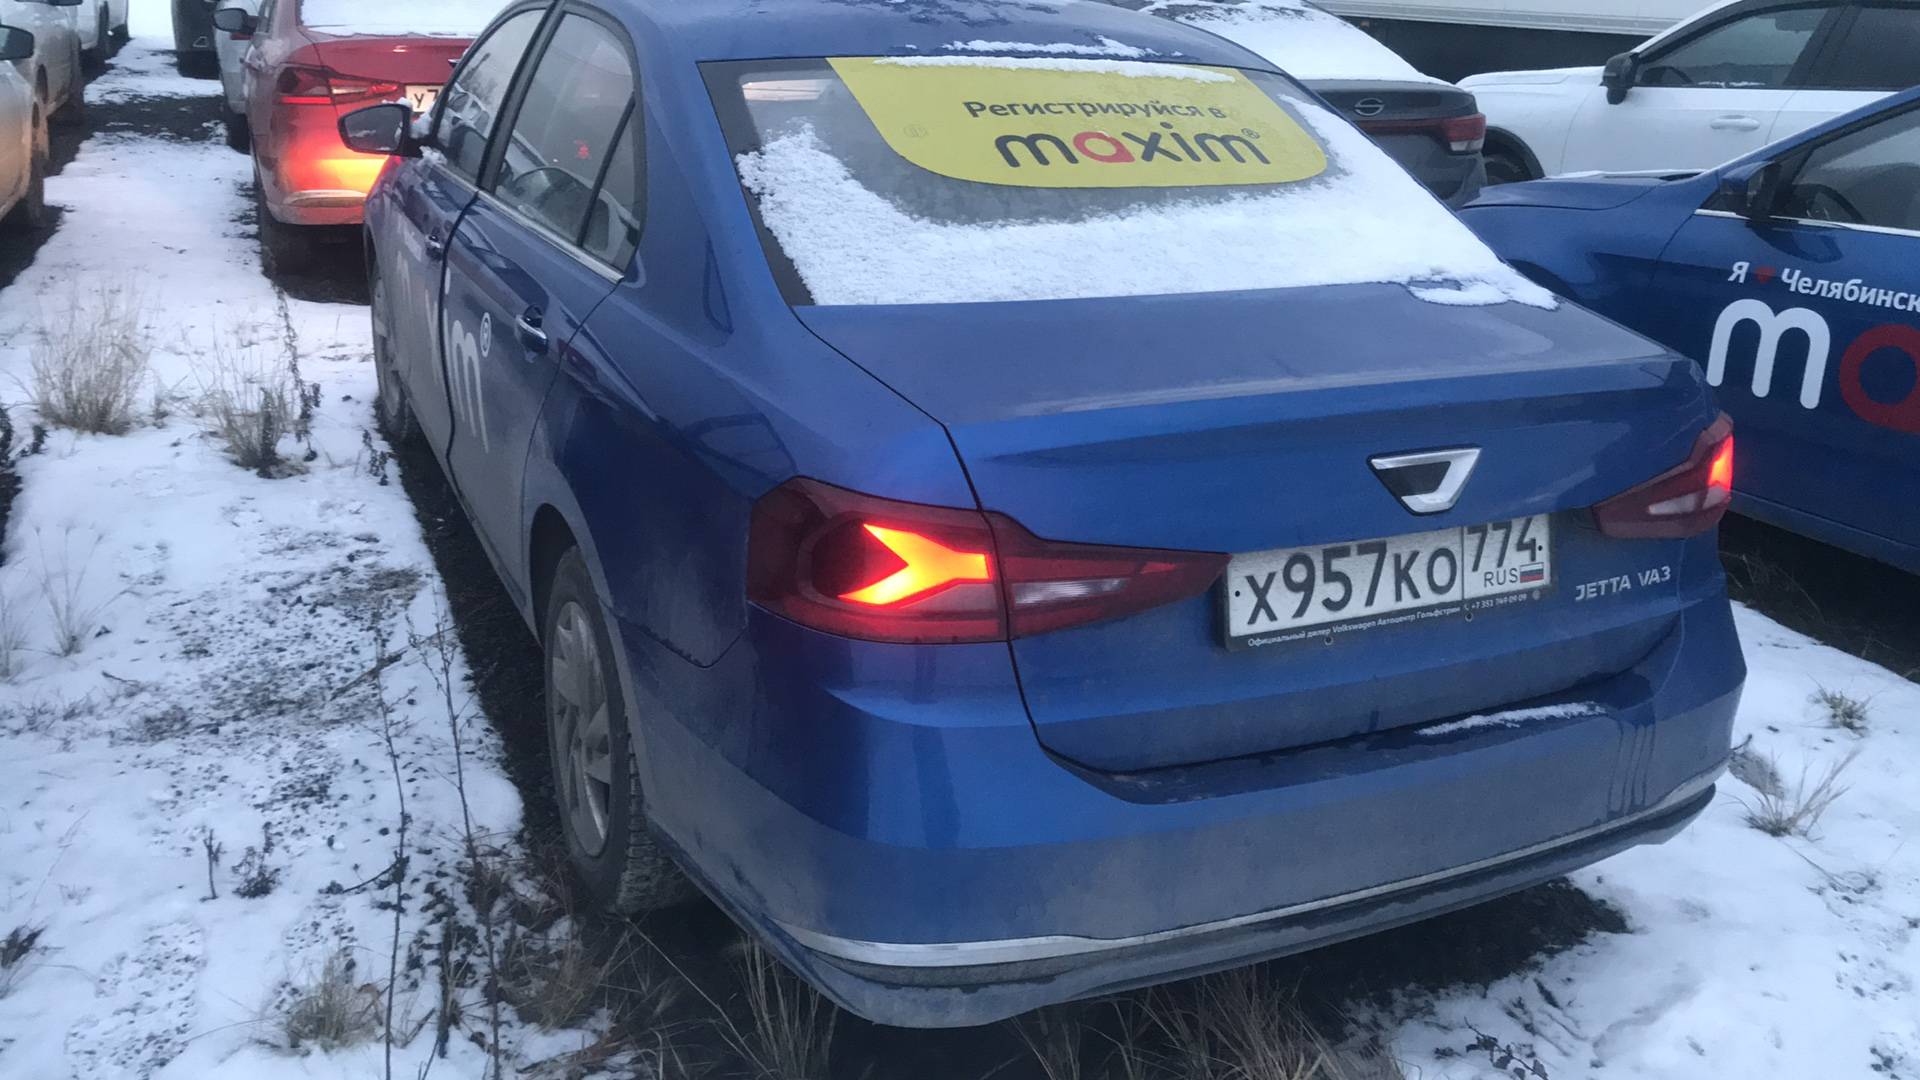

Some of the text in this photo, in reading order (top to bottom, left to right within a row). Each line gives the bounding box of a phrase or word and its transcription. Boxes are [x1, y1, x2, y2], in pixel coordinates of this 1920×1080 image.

[962, 100, 1227, 119] Регистрируйся в
[994, 121, 1271, 168] maxim
[1727, 261, 1750, 283] Я
[1466, 517, 1537, 572] 774
[1483, 566, 1518, 589] RUS
[1575, 565, 1671, 601] JETTA VA3
[1332, 620, 1377, 634] Volkswagen
